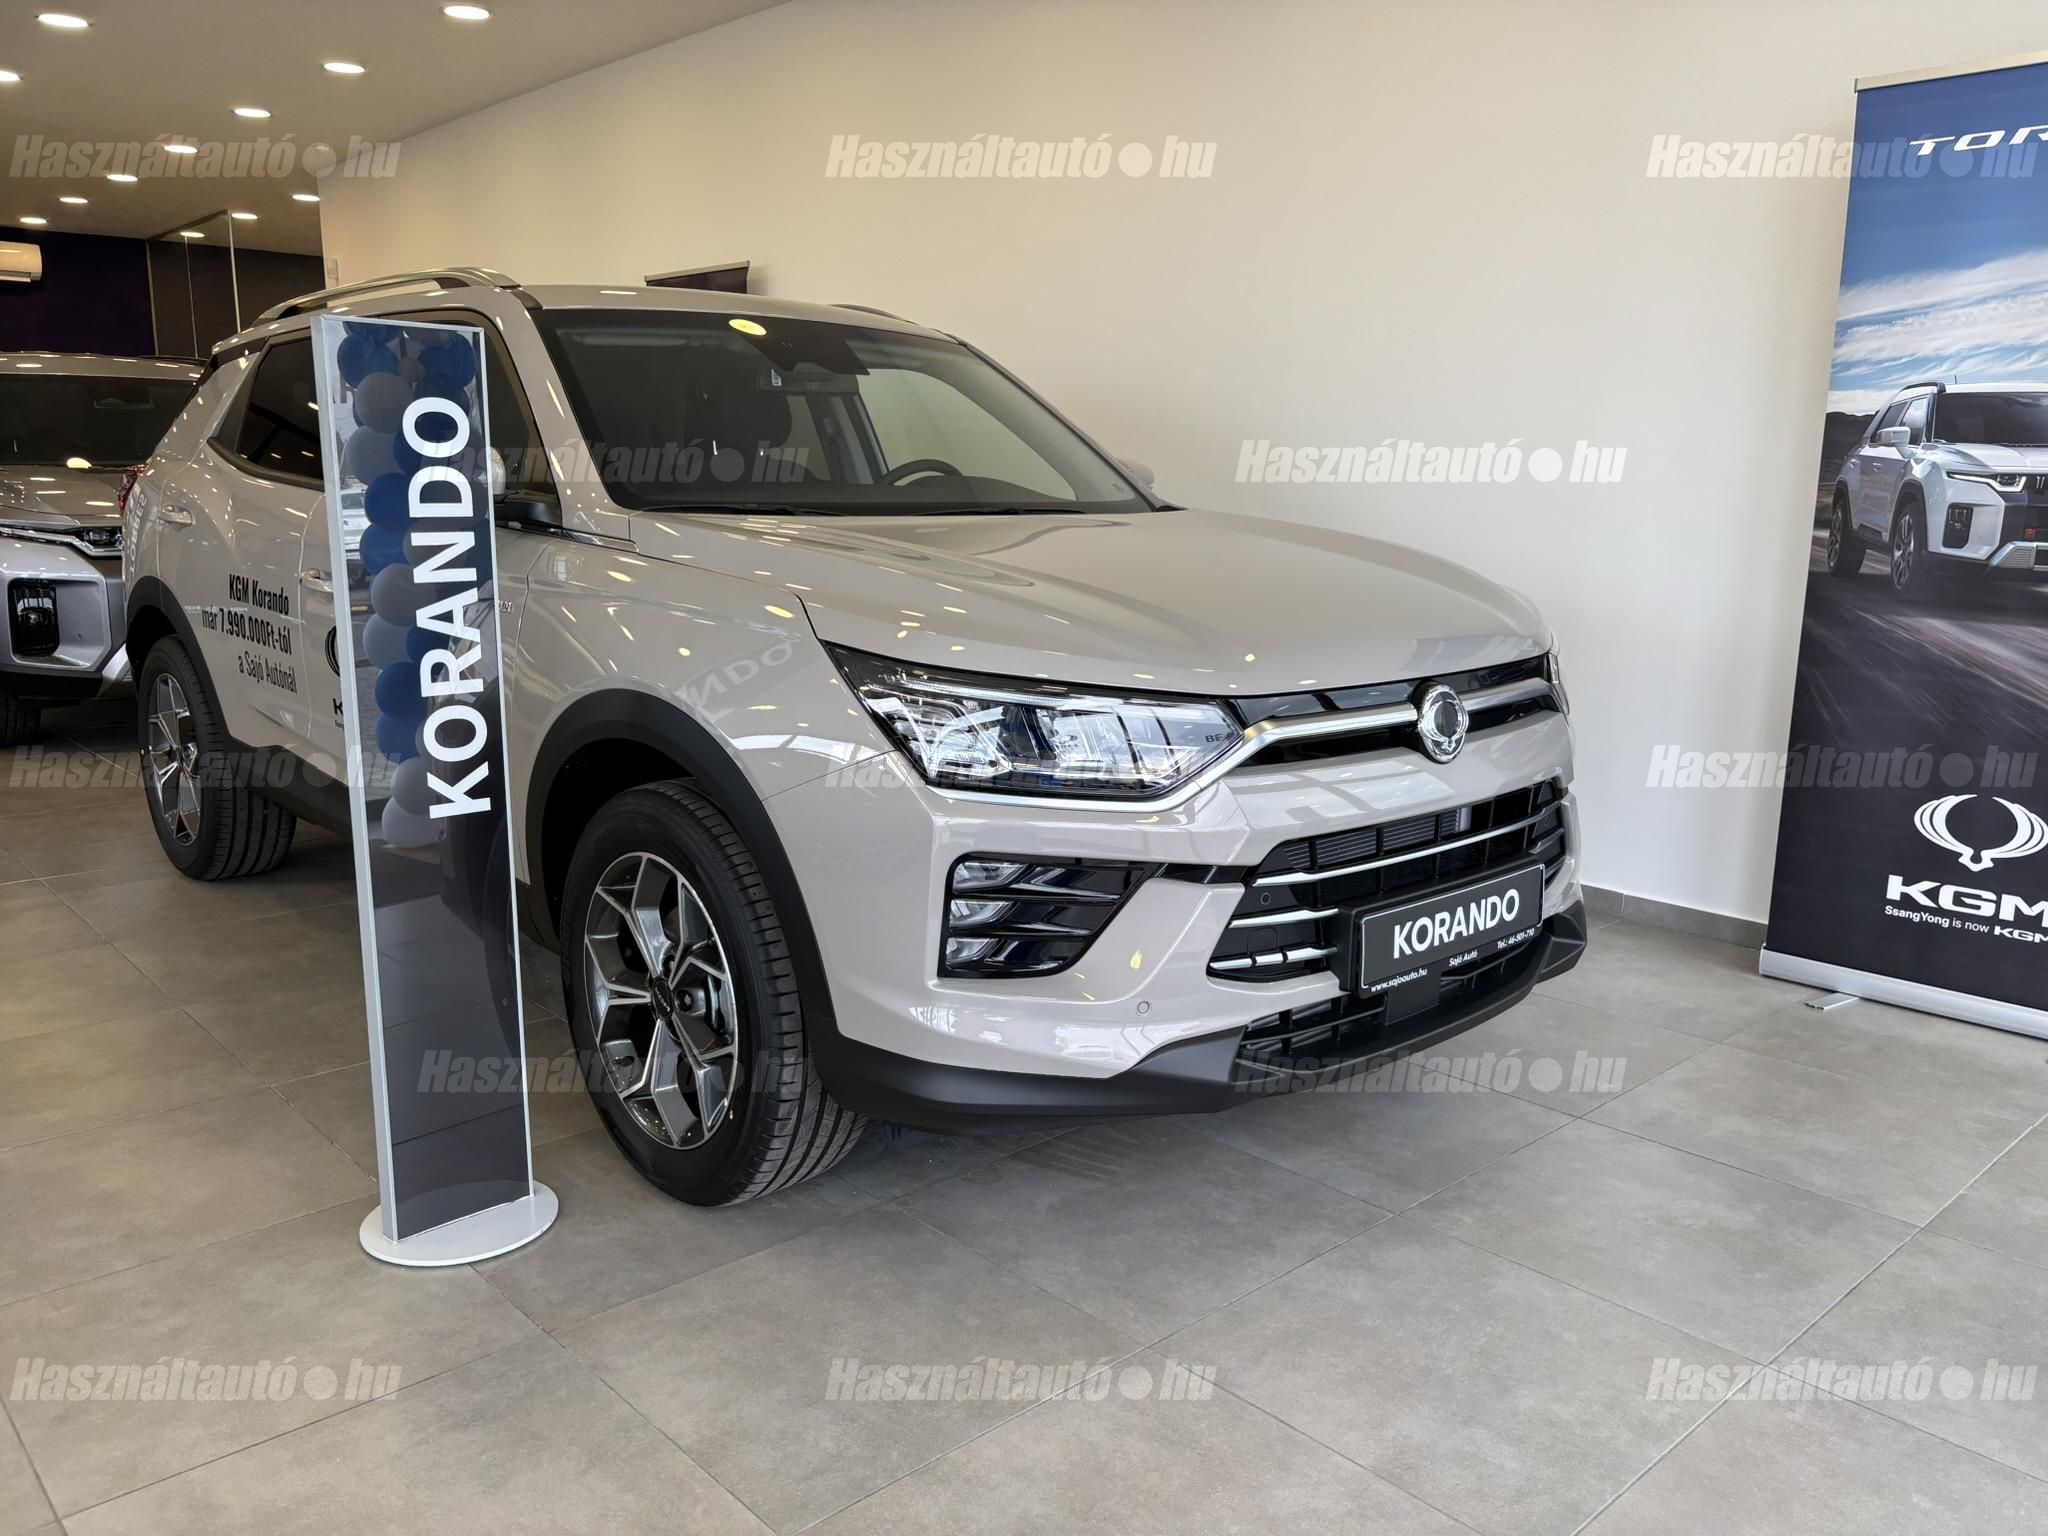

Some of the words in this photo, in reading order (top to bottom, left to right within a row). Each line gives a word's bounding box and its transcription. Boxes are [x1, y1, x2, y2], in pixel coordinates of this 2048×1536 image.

[229, 573, 250, 603] KGM
[252, 580, 289, 615] Korando
[402, 397, 492, 819] KORANDO
[202, 604, 218, 630] már
[219, 608, 292, 655] 7.990.000Ft-tól
[238, 654, 245, 674] a
[244, 651, 264, 683] Sajó
[265, 658, 297, 694] Autónál
[1885, 905, 1950, 928] SsangYong
[1952, 917, 1962, 928] is
[1964, 920, 1990, 933] now
[1886, 874, 2048, 928] KGM
[1393, 888, 1520, 959] KORANDO
[1463, 949, 1478, 962] Autó
[1370, 967, 1428, 992] www.sajoauto.hu
